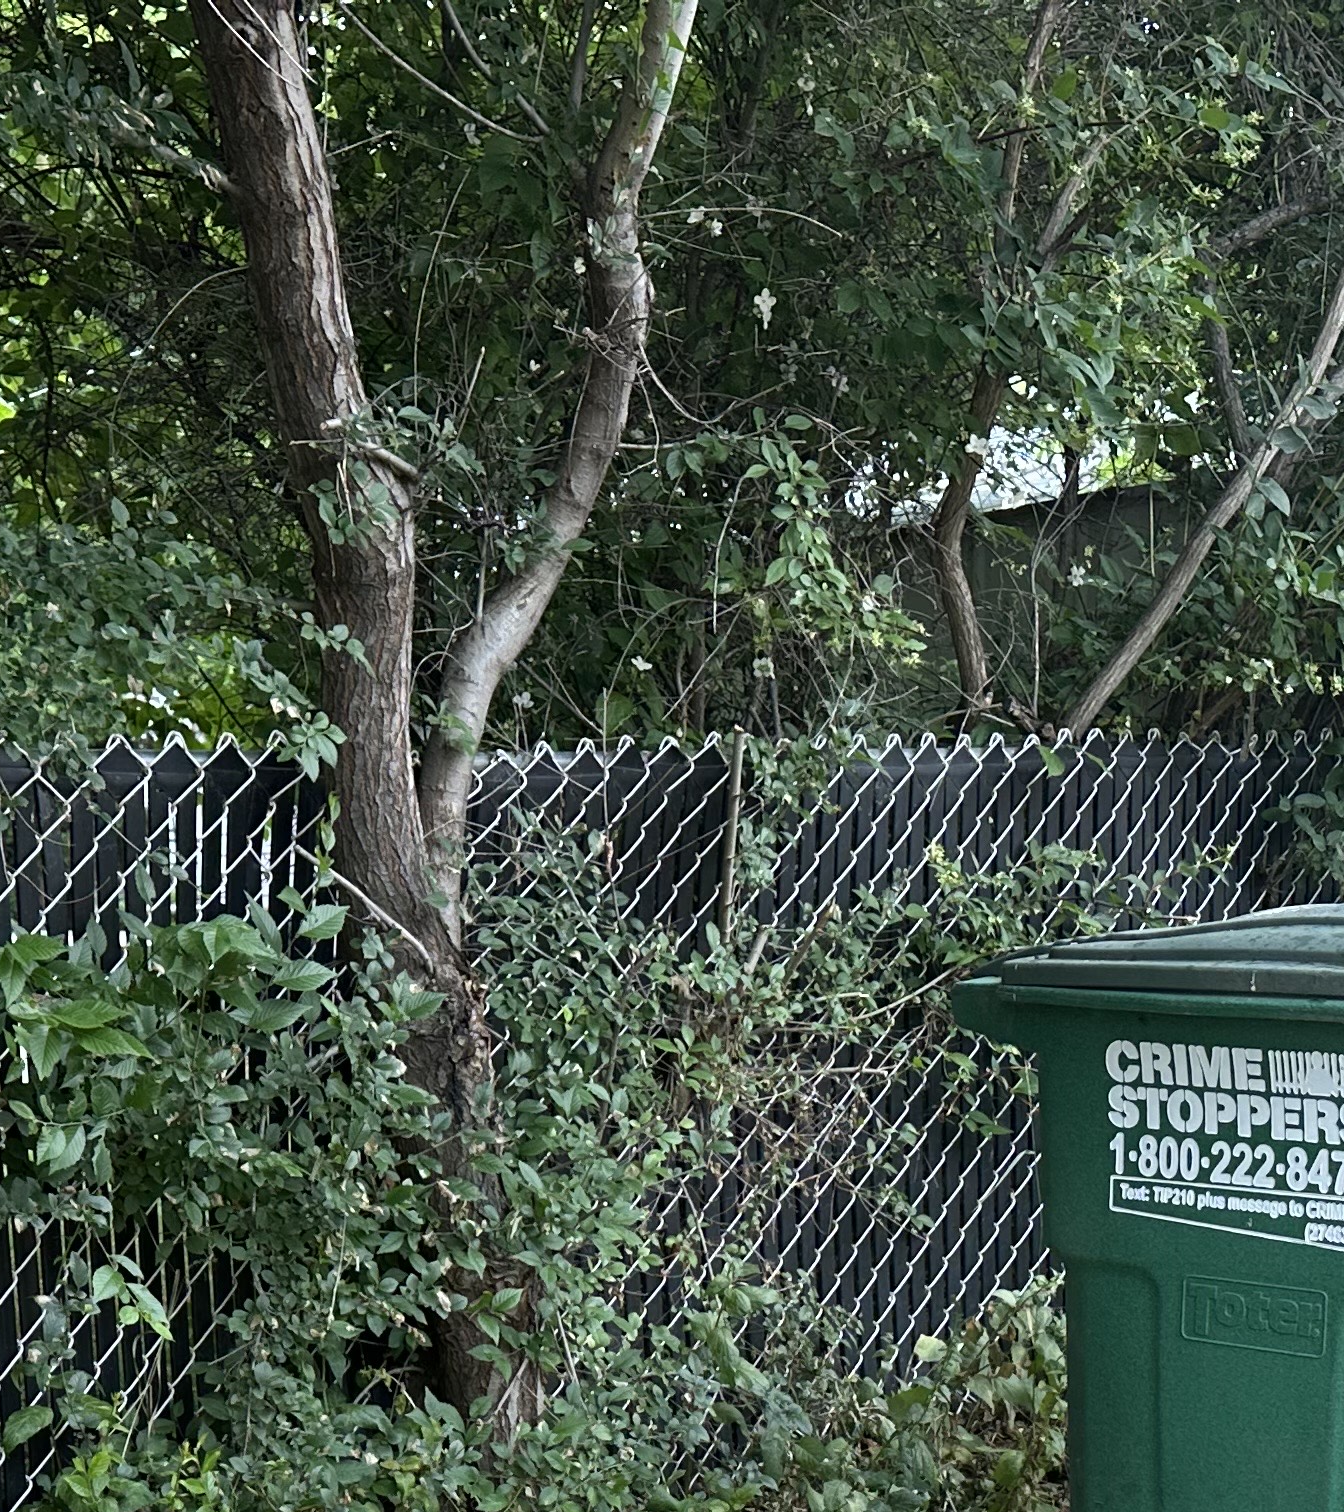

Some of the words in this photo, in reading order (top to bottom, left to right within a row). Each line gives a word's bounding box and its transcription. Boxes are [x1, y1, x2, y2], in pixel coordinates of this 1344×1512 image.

[1106, 1039, 1266, 1092] CRIME
[1119, 1182, 1150, 1201] Text:
[1153, 1185, 1195, 1206] TIP210
[1197, 1191, 1226, 1210] plus
[1227, 1196, 1288, 1218] message
[1288, 1199, 1305, 1218] to
[1186, 1282, 1322, 1337] Toter
